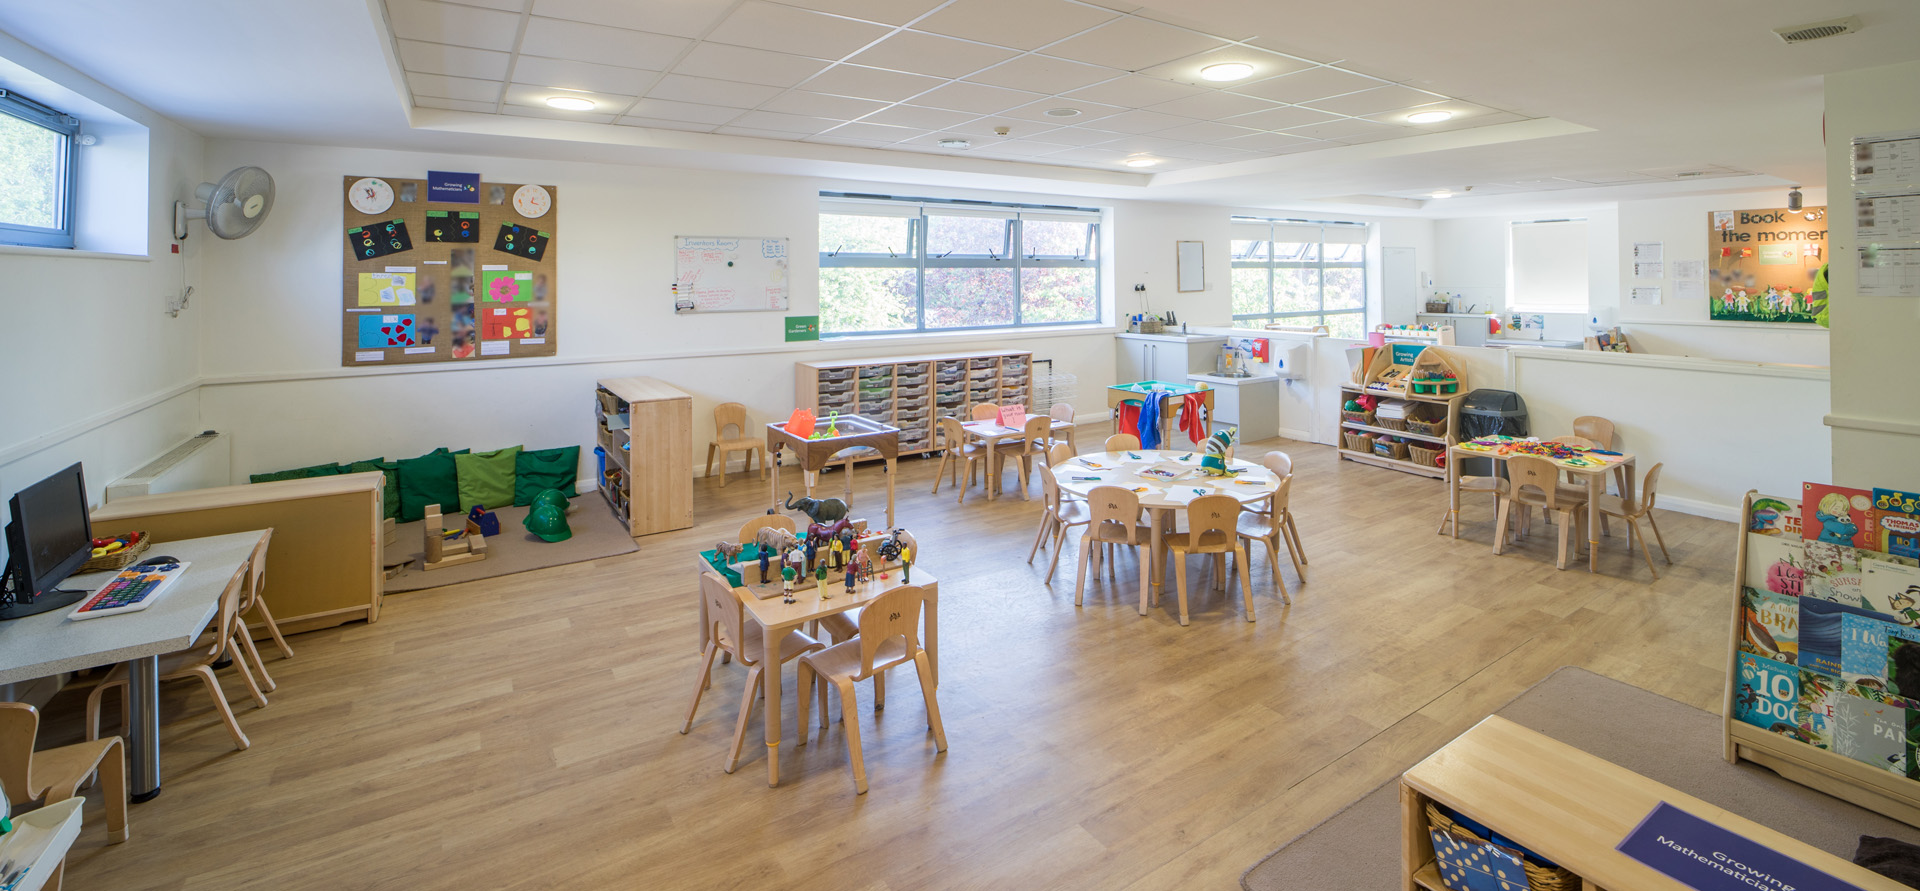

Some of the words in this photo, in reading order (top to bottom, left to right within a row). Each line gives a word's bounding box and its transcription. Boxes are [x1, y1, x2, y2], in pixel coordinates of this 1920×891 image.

[1740, 211, 1786, 225] Book
[685, 238, 715, 246] Inventors
[1721, 230, 1751, 243] the
[1885, 518, 1919, 528] THOMAS
[1829, 586, 1861, 603] Snow
[1851, 627, 1857, 641] I
[1884, 625, 1899, 637] Tony
[1900, 629, 1916, 640] Ross
[1761, 663, 1789, 675] Michael
[1756, 669, 1798, 702] 10
